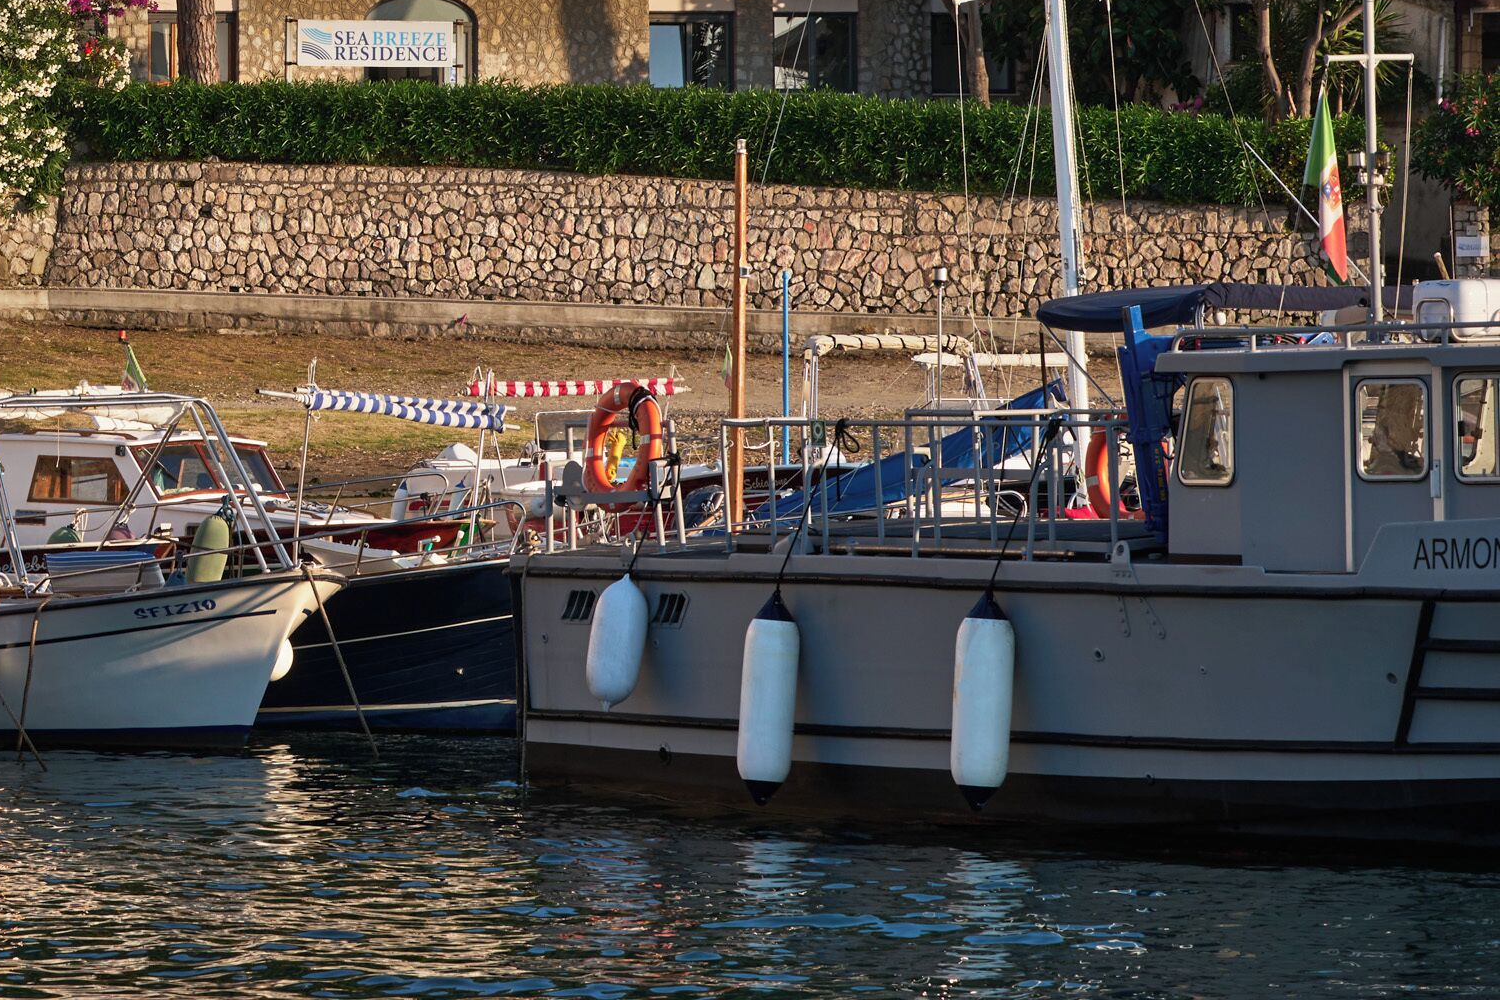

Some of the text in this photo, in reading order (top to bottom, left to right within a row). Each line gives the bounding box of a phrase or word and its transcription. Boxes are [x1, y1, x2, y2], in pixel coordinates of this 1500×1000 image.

[334, 30, 447, 47] SEA BREEZE
[334, 46, 448, 62] RESIDENCE
[133, 599, 216, 619] SFIZIO
